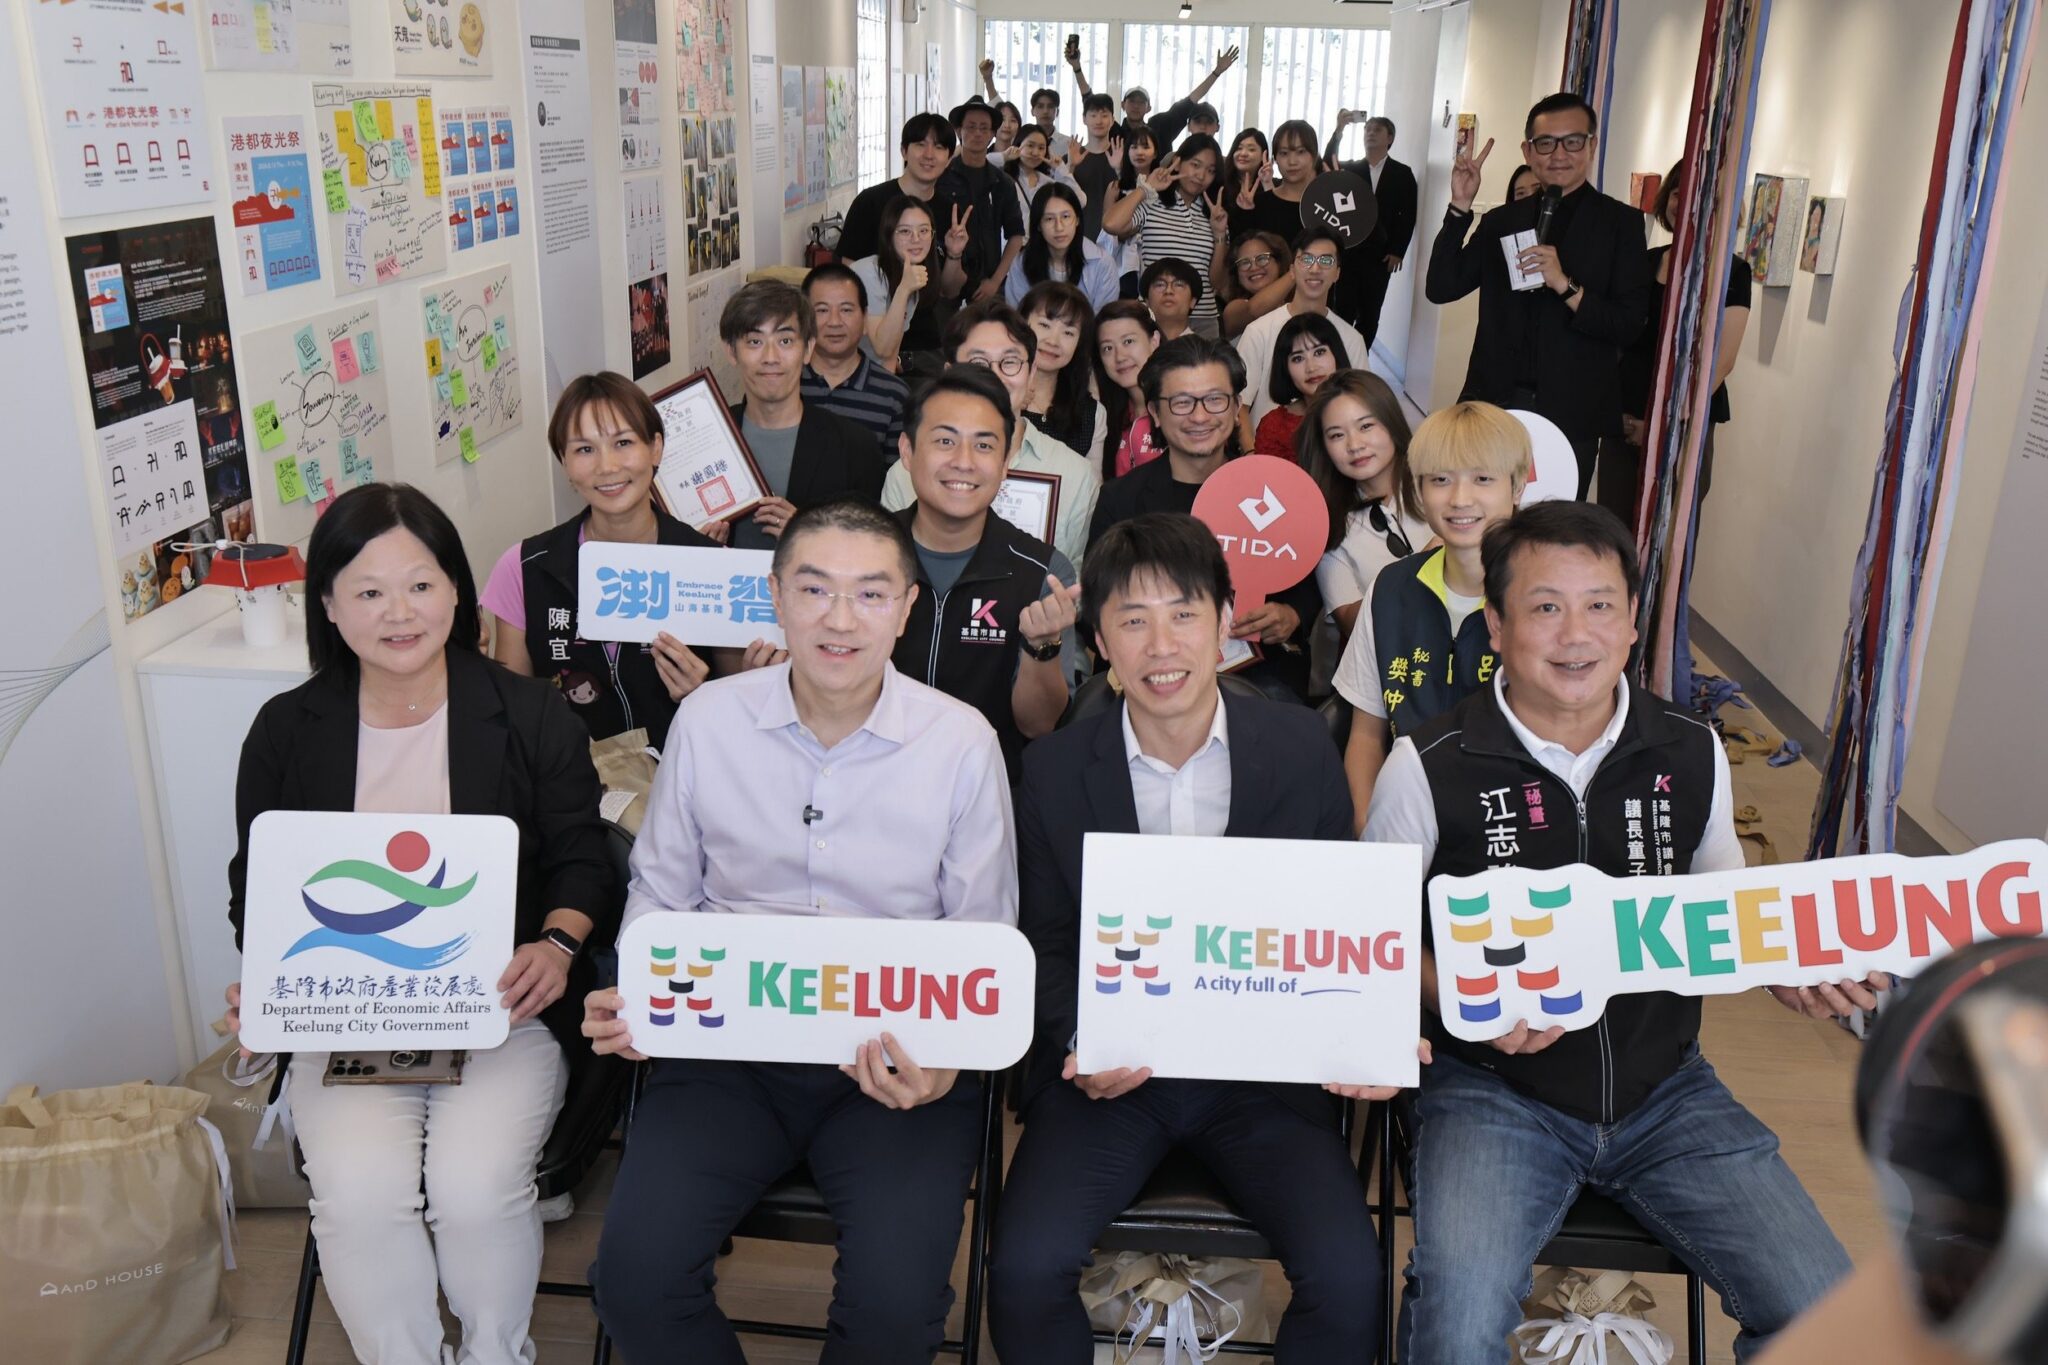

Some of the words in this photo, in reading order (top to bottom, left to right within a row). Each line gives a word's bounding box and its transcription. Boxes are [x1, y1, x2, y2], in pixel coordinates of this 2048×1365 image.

[231, 131, 300, 151] 港都夜光祭
[1314, 202, 1351, 237] TIDA
[1216, 534, 1297, 561] TIDA
[676, 581, 724, 590] Embrace
[678, 590, 722, 601] Keelung
[674, 603, 723, 614] 山海基隆
[1411, 647, 1430, 687] 秘書
[1479, 787, 1520, 868] 江志
[1612, 861, 2044, 977] KEELUNG
[1194, 924, 1405, 975] KEELUNG
[268, 975, 487, 1002] 基隆市政府產業發展處
[748, 960, 1000, 1021] KEELUNG
[1195, 976, 1207, 990] A
[1210, 976, 1242, 995] city
[1245, 976, 1274, 993] full
[1278, 978, 1297, 993] of
[262, 1002, 350, 1017] Department
[354, 1002, 369, 1014] of
[373, 1002, 440, 1014] Economic
[443, 1001, 492, 1014] Affairs
[283, 1020, 344, 1033] Keelung
[348, 1019, 378, 1033] City
[382, 1019, 470, 1032] Government
[105, 1262, 164, 1286] HOUSE
